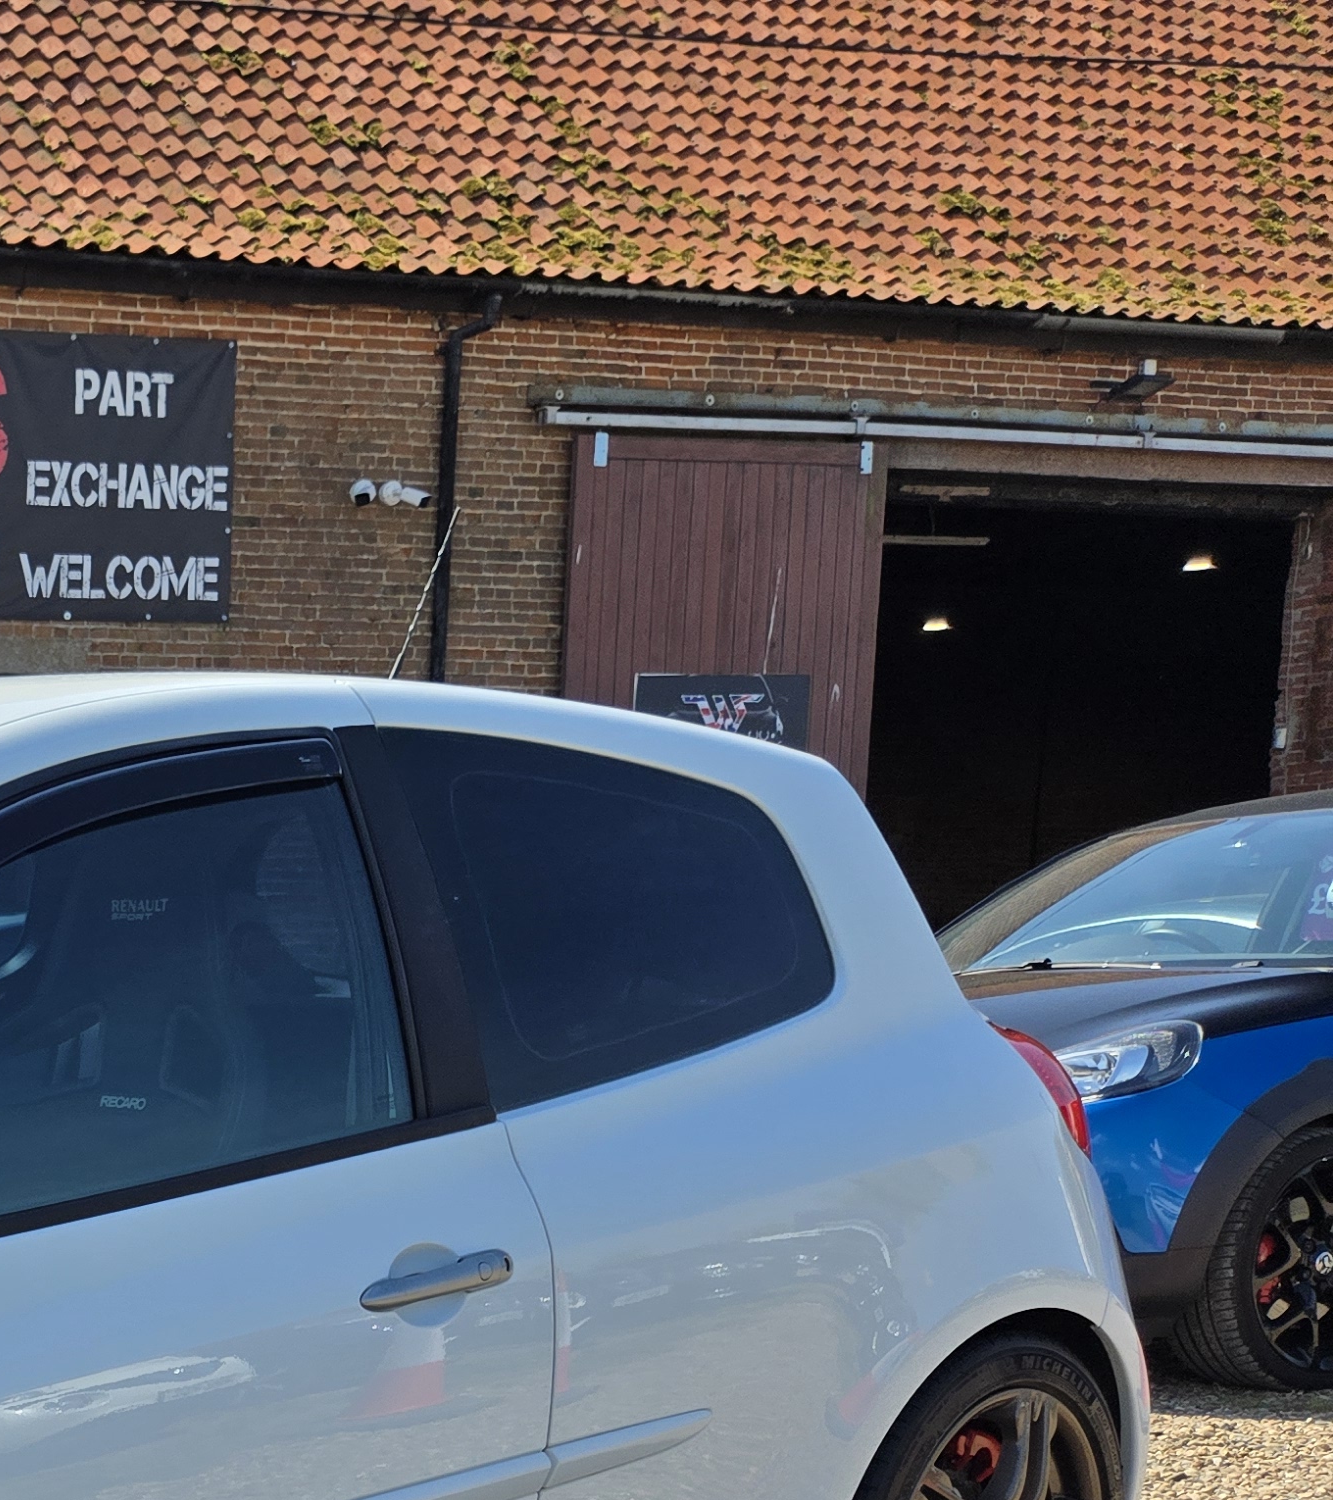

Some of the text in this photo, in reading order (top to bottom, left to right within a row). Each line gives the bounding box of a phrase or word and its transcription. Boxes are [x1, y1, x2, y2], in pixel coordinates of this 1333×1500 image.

[74, 368, 175, 419] PART
[26, 460, 229, 512] EXCHANGE
[19, 552, 220, 602] WELCOME
[111, 898, 169, 912] RENAULT
[99, 1095, 147, 1111] RECARO
[1021, 1355, 1092, 1403] MICHELIN
